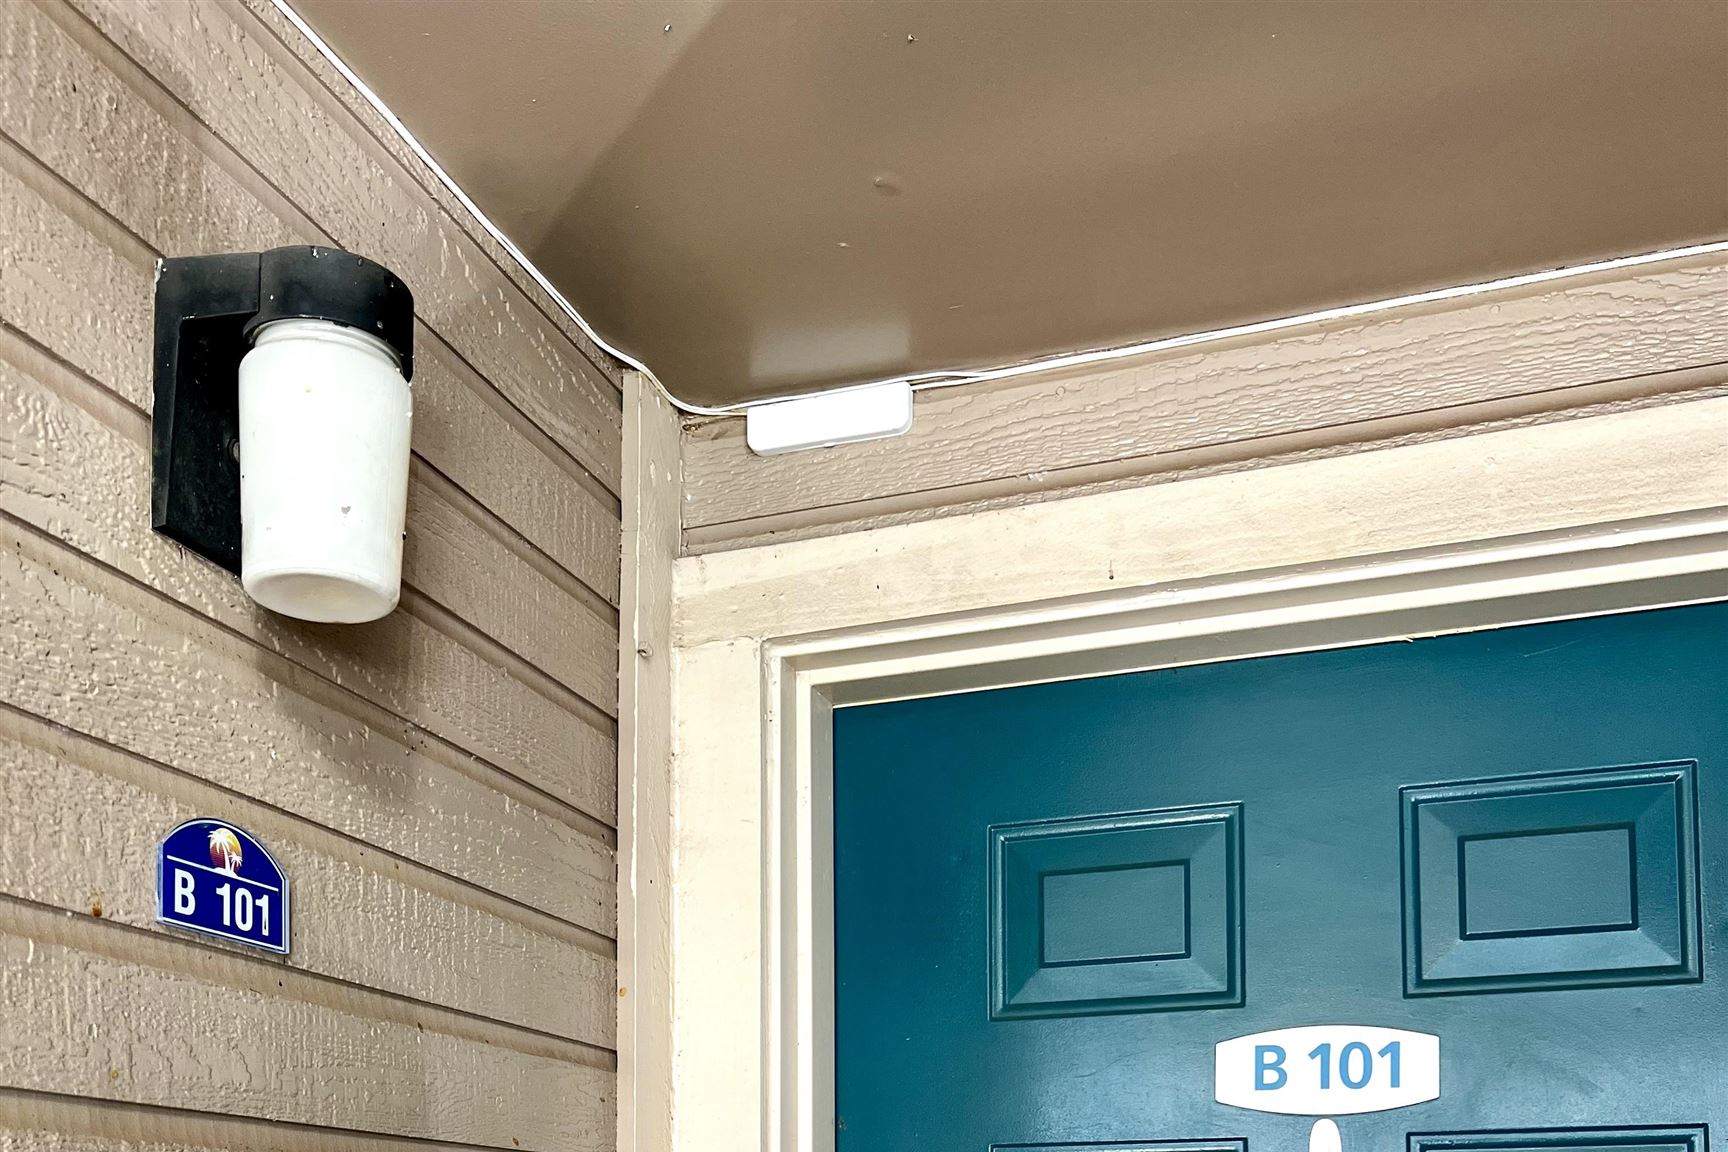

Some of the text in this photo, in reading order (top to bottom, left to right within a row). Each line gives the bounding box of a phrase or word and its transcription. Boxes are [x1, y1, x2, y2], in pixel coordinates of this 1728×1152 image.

[174, 868, 269, 937] B 101
[1254, 1041, 1401, 1091] B 101
